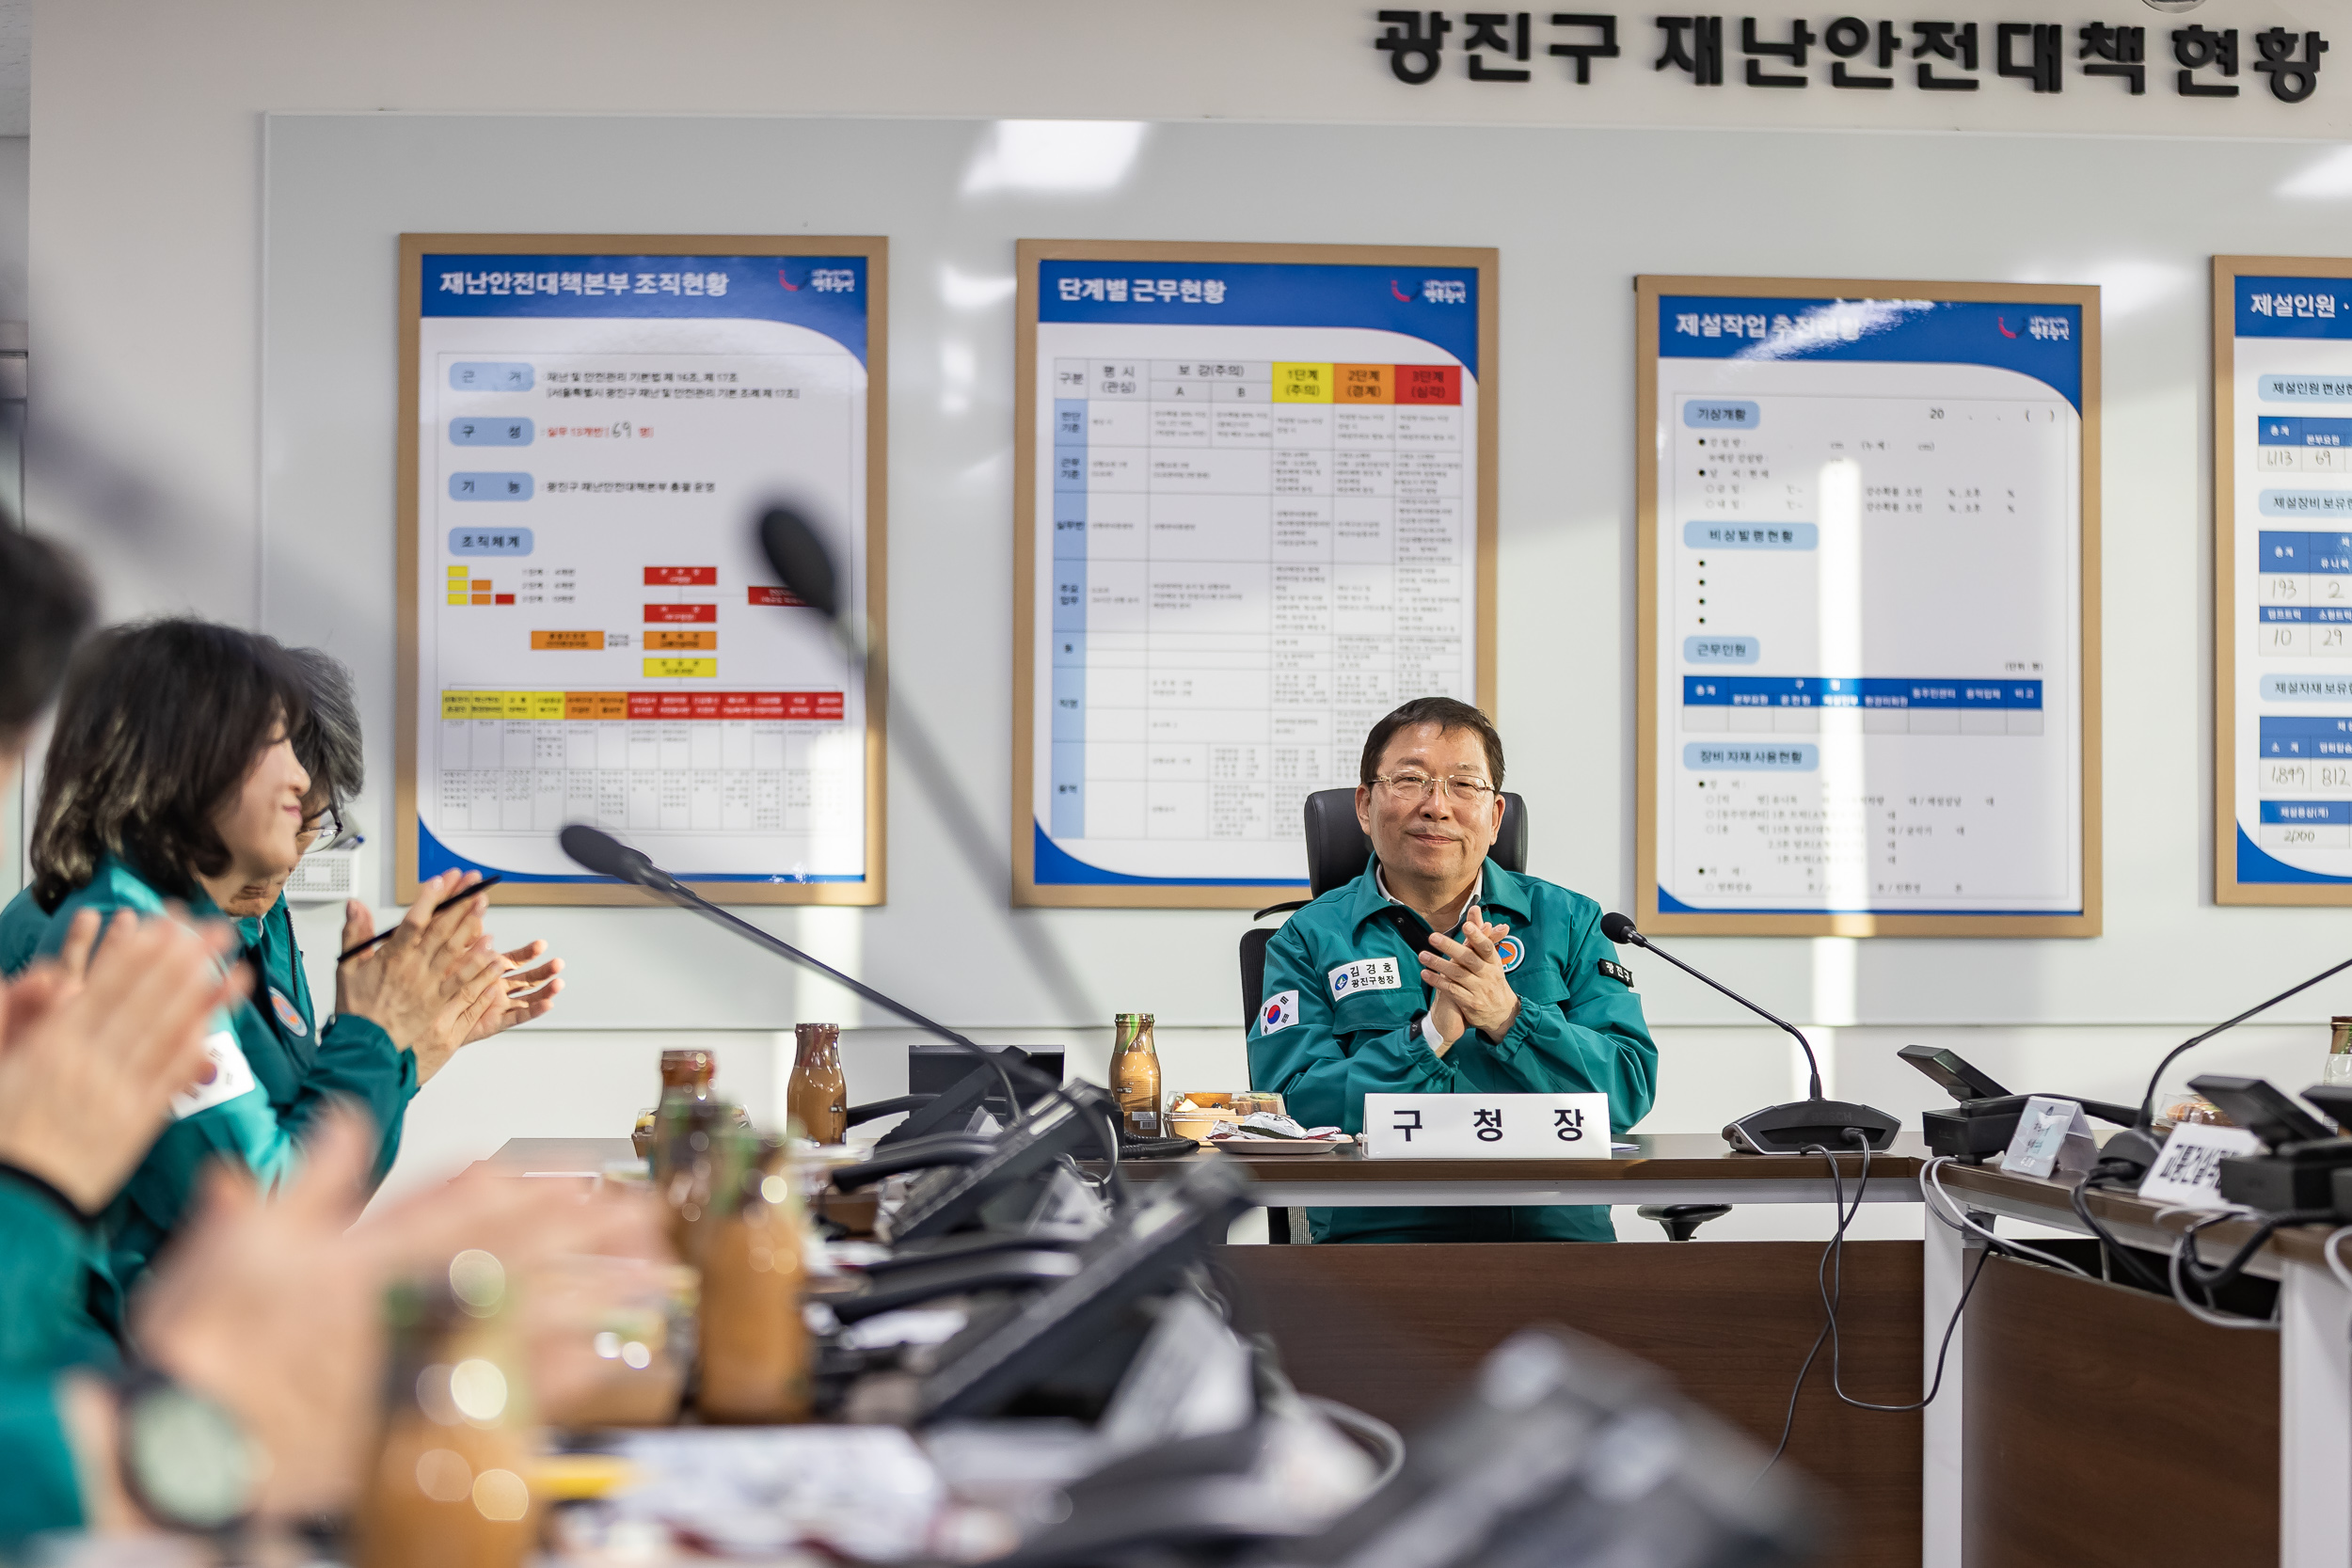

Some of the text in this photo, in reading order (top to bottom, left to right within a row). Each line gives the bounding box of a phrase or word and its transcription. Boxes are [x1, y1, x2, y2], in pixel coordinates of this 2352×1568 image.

[1375, 10, 1620, 86] 광진구
[439, 272, 730, 297] 재난안전대책본부 조직현황
[1057, 277, 1228, 305] 단계별 근무현황
[2249, 293, 2336, 319] 제설인원
[1677, 312, 1767, 338] 제설작업
[2273, 381, 2320, 396] 제설인원
[1351, 975, 1394, 989] 광진구청장
[1605, 961, 1630, 982] 광진구
